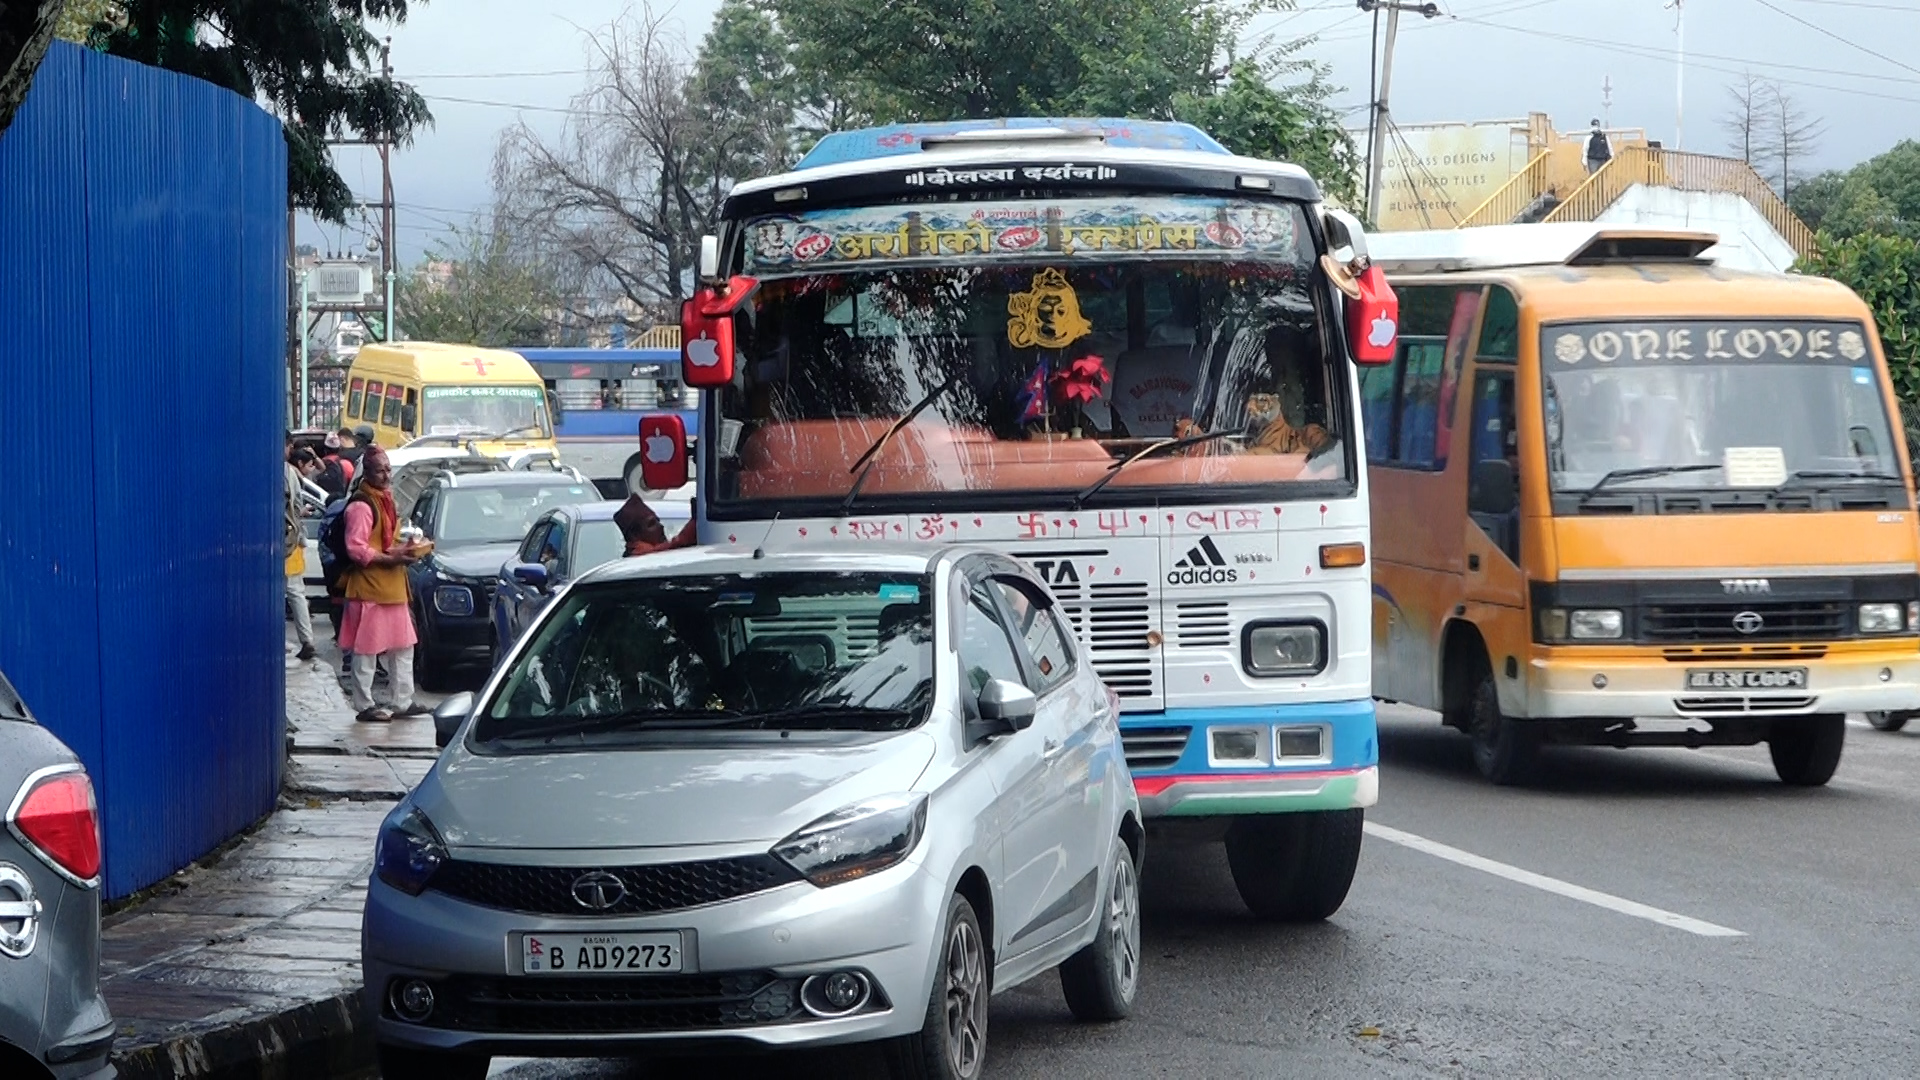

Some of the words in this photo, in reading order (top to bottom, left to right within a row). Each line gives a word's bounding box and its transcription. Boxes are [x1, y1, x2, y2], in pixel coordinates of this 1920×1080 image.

[1443, 151, 1496, 166] DESIGNS
[1453, 175, 1486, 187] TILES
[1588, 328, 1696, 363] ONE
[1704, 328, 1837, 361] LOVE
[1167, 567, 1238, 585] adidas
[1719, 579, 1771, 595] TATA
[550, 946, 565, 970] B
[577, 945, 672, 970] AD9273
